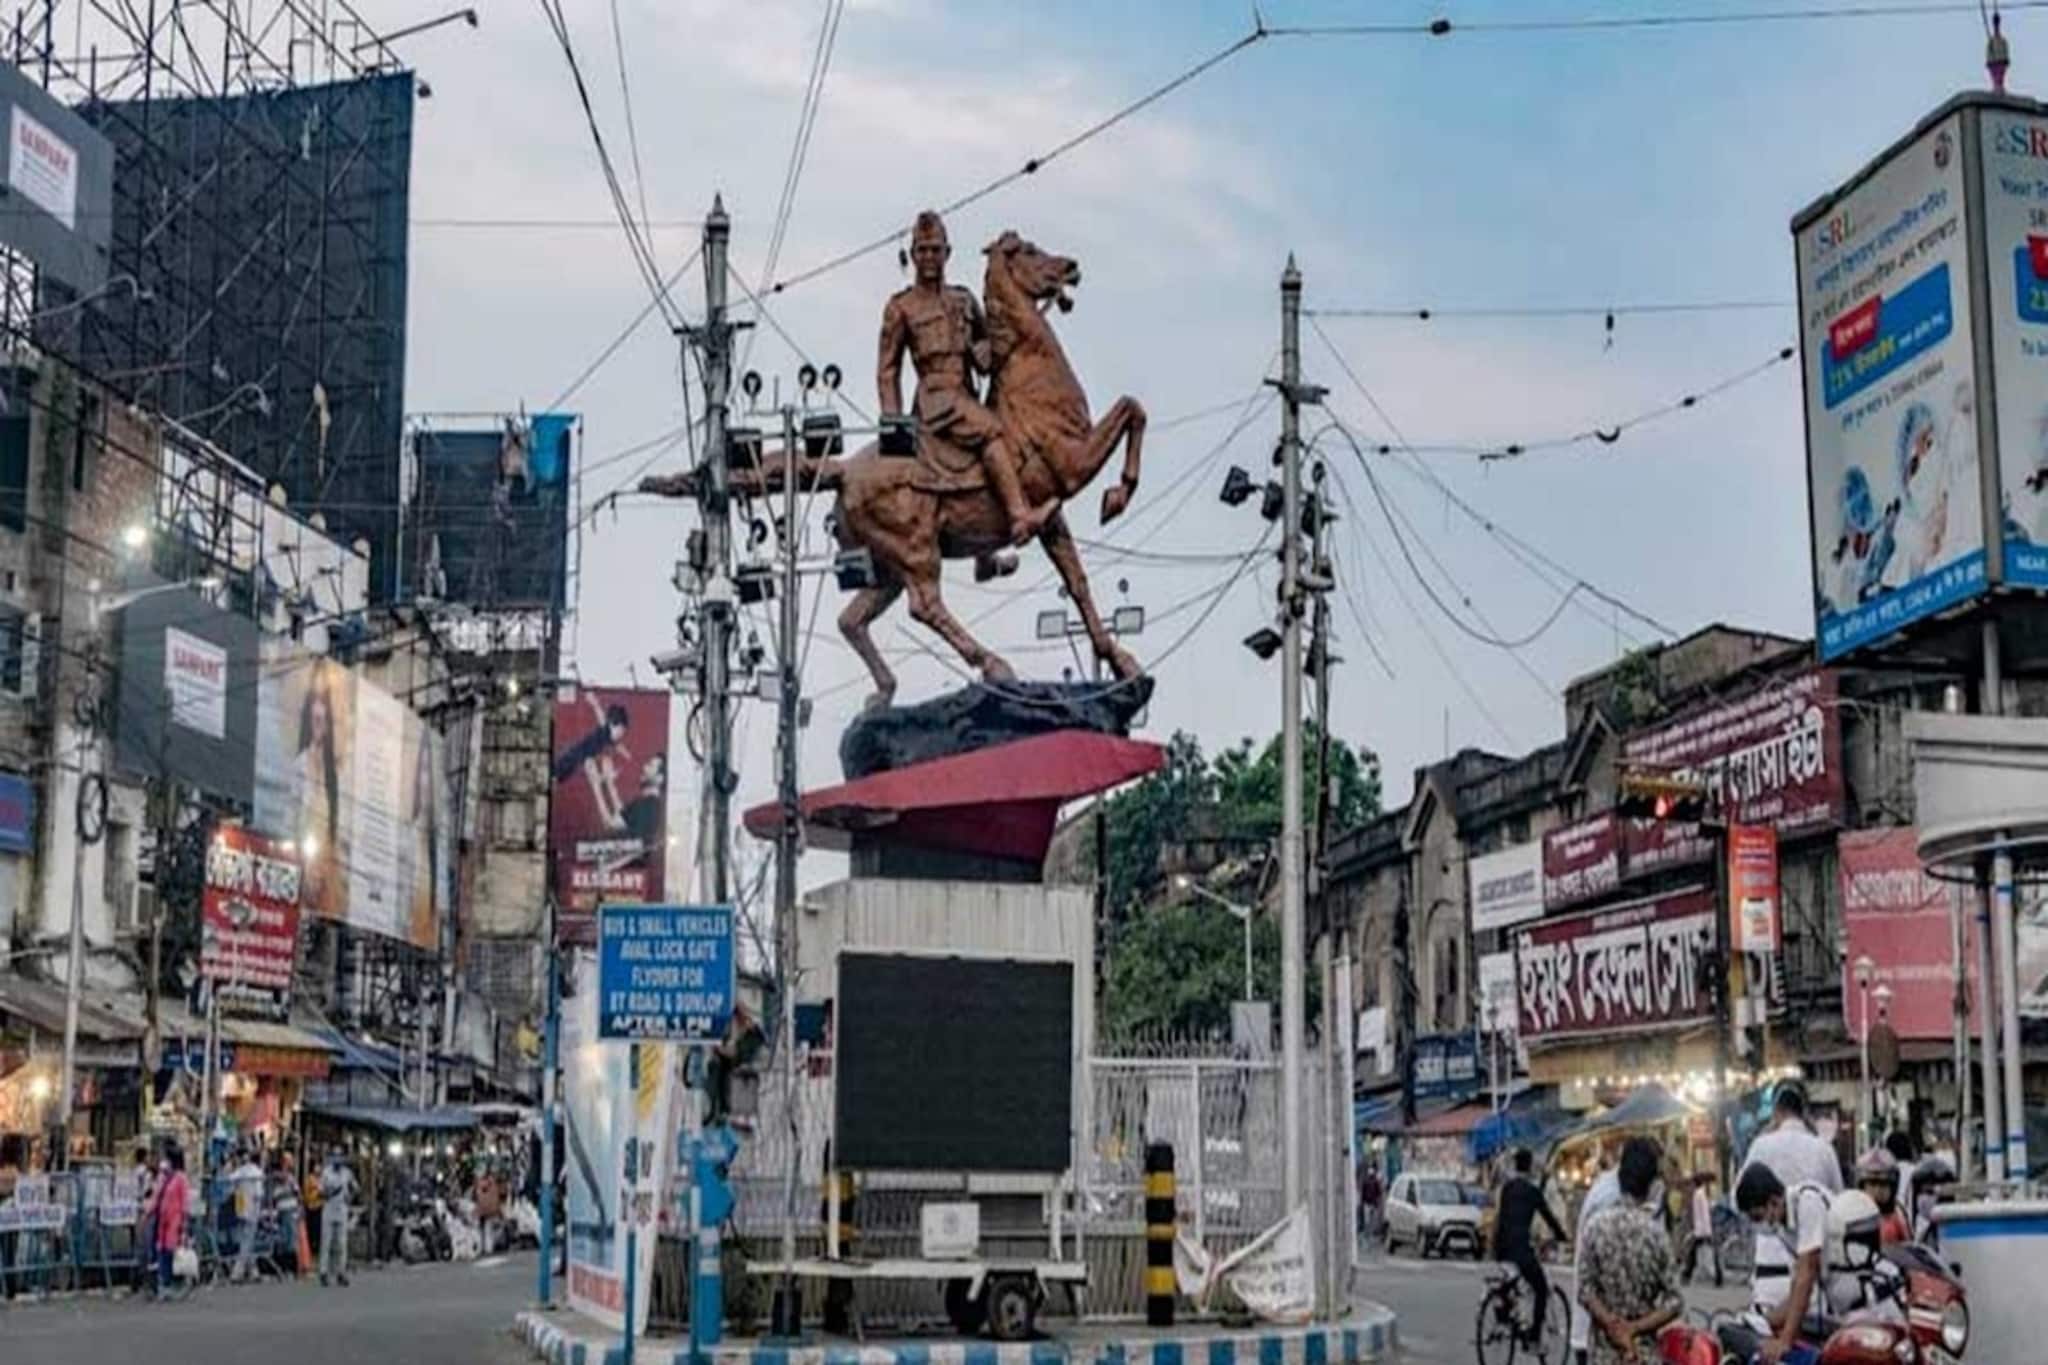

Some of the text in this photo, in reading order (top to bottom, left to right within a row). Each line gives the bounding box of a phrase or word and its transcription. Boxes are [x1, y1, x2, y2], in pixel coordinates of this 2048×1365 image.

[638, 914, 674, 936] SMALL
[676, 914, 728, 936] VEHICLES
[655, 939, 685, 961] LOCK
[629, 990, 660, 1013] ROAD
[675, 990, 724, 1014] DUNLOP
